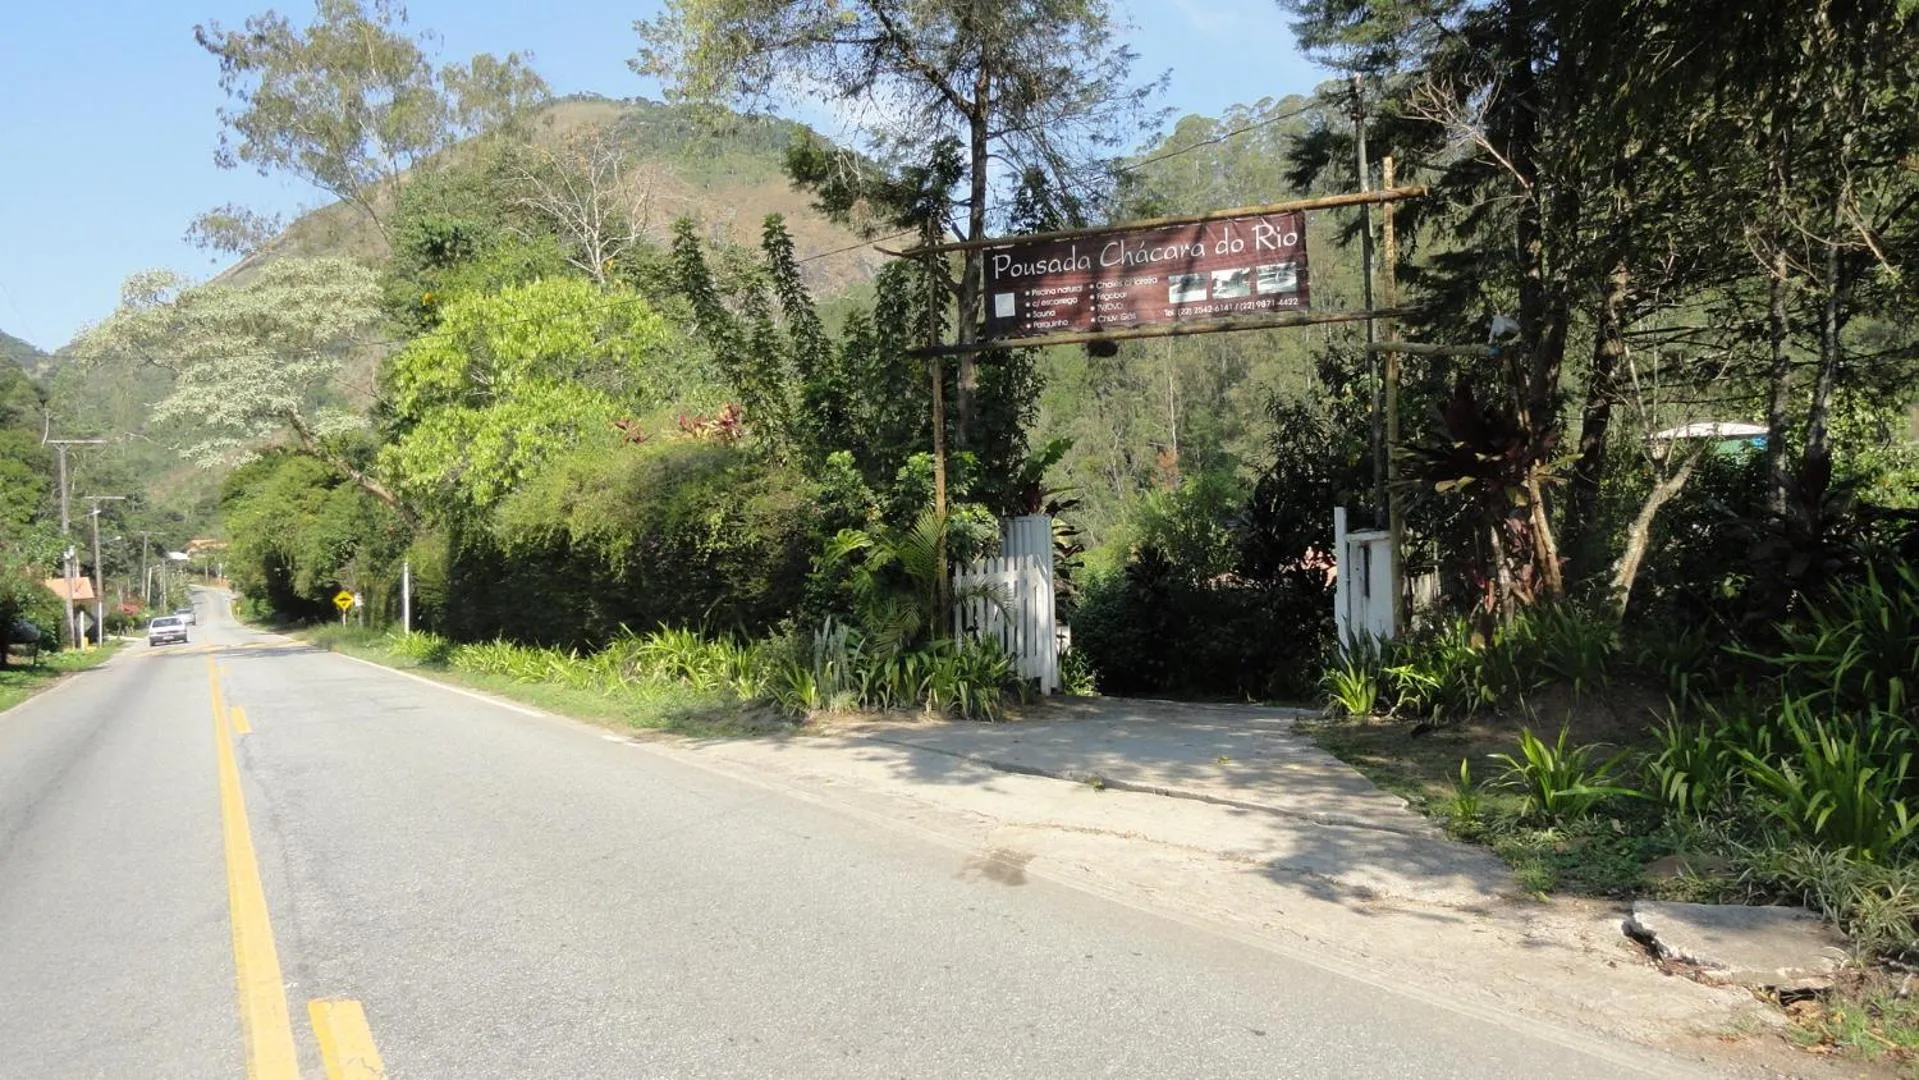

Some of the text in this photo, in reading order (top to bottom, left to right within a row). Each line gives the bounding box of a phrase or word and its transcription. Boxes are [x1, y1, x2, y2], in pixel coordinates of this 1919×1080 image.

[992, 223, 1298, 280] Pousada Chácara do Rio
[1031, 285, 1083, 297] Piscina natural
[1032, 310, 1056, 319] Sauna
[1033, 319, 1069, 330] Parquinho
